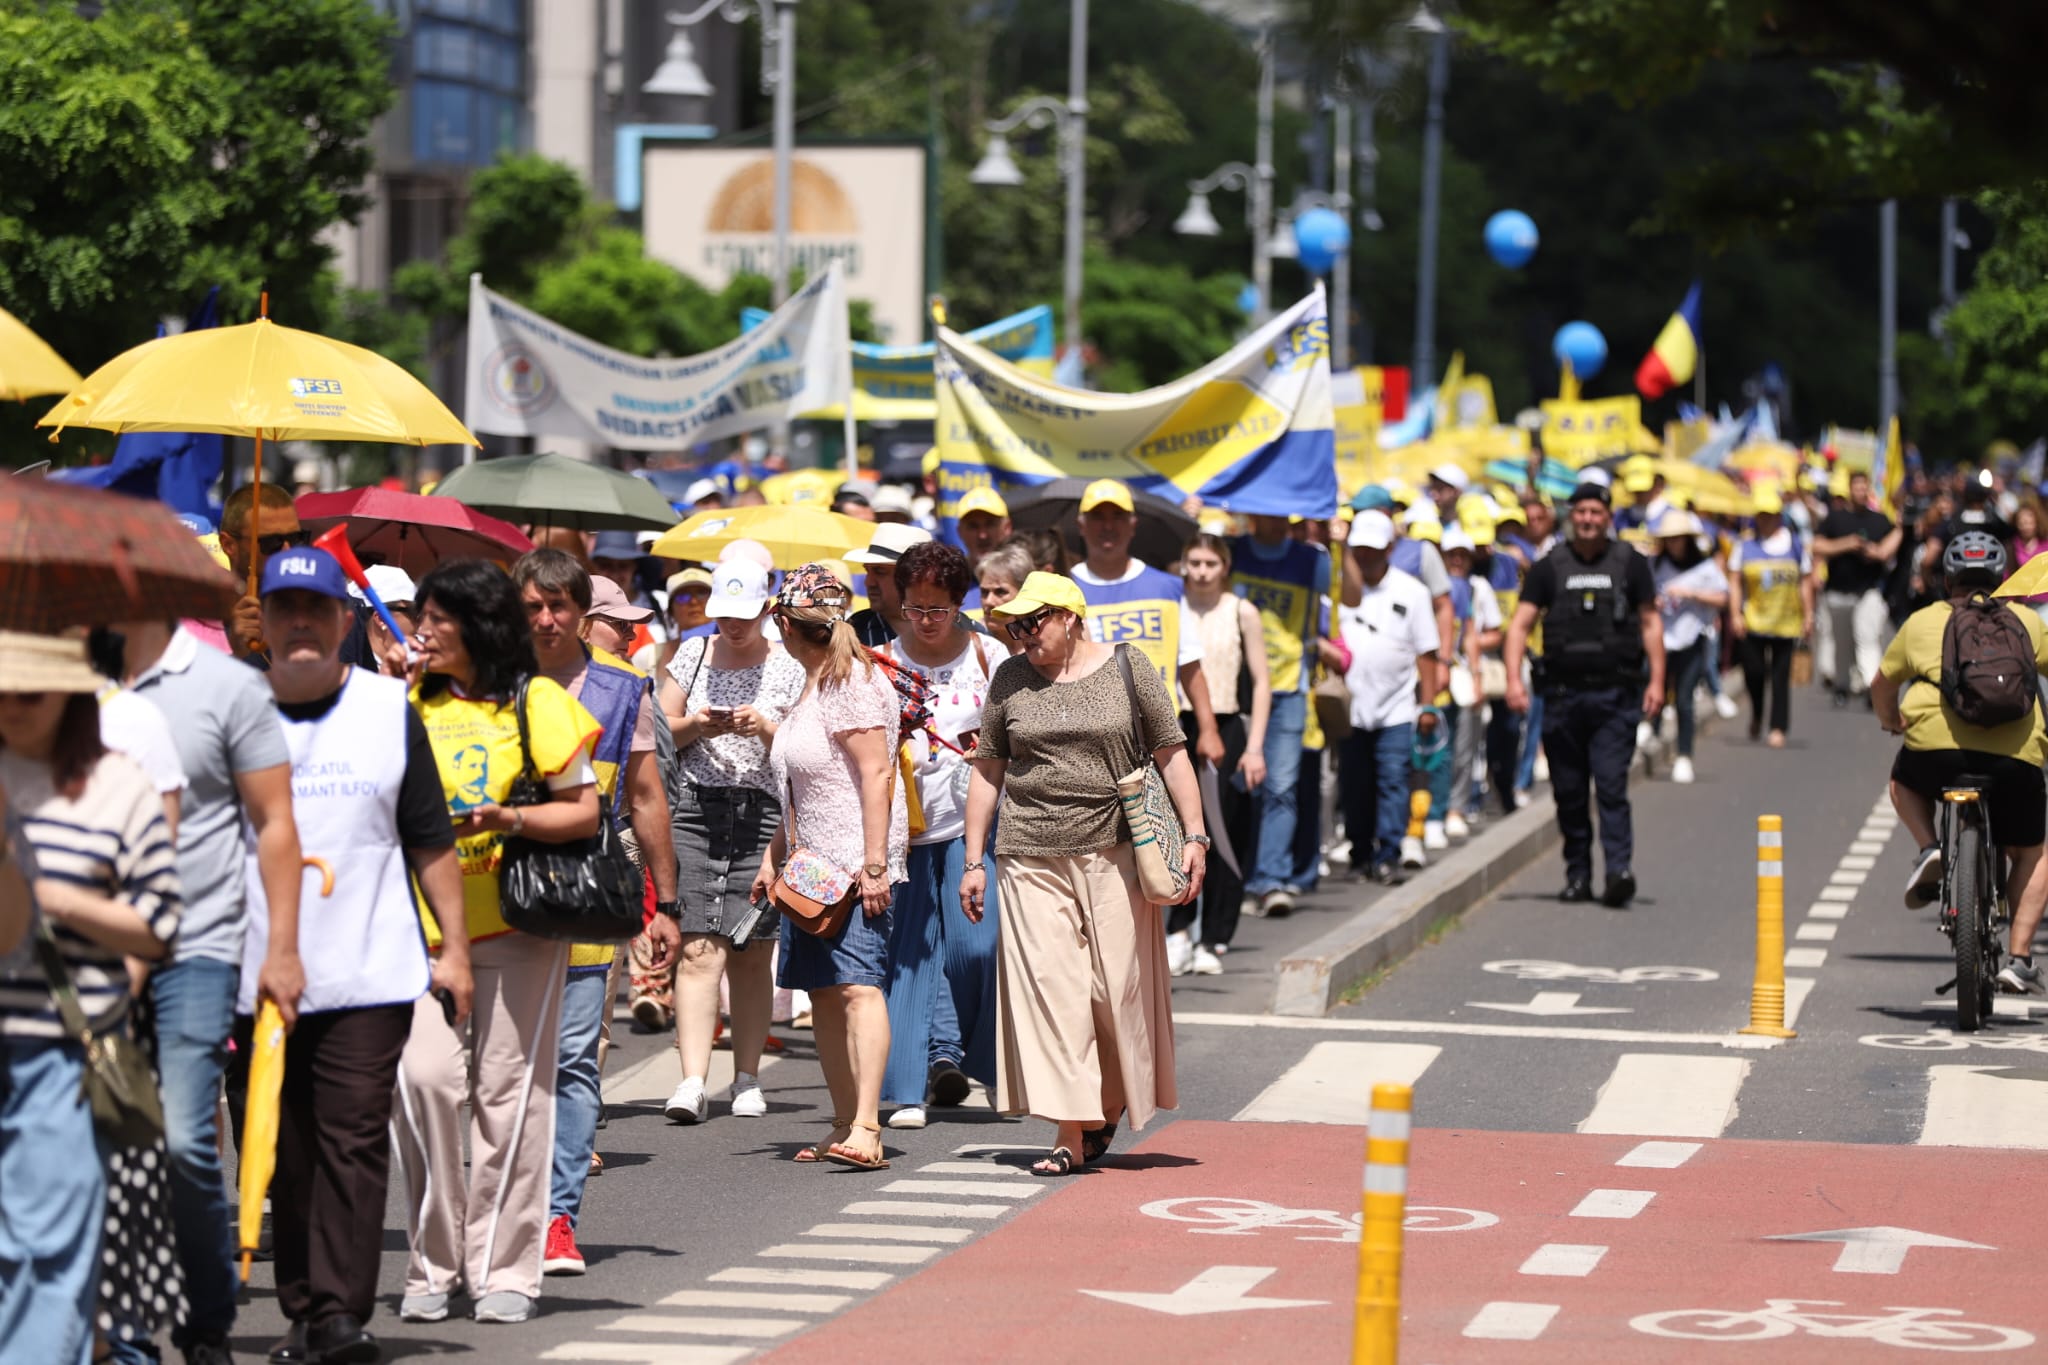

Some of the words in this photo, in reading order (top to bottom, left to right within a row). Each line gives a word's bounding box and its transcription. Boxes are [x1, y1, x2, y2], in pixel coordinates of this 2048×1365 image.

[303, 380, 341, 393] FSE
[280, 556, 317, 576] FSLI
[1102, 611, 1162, 640] FSE
[341, 780, 380, 796] ILFOV
